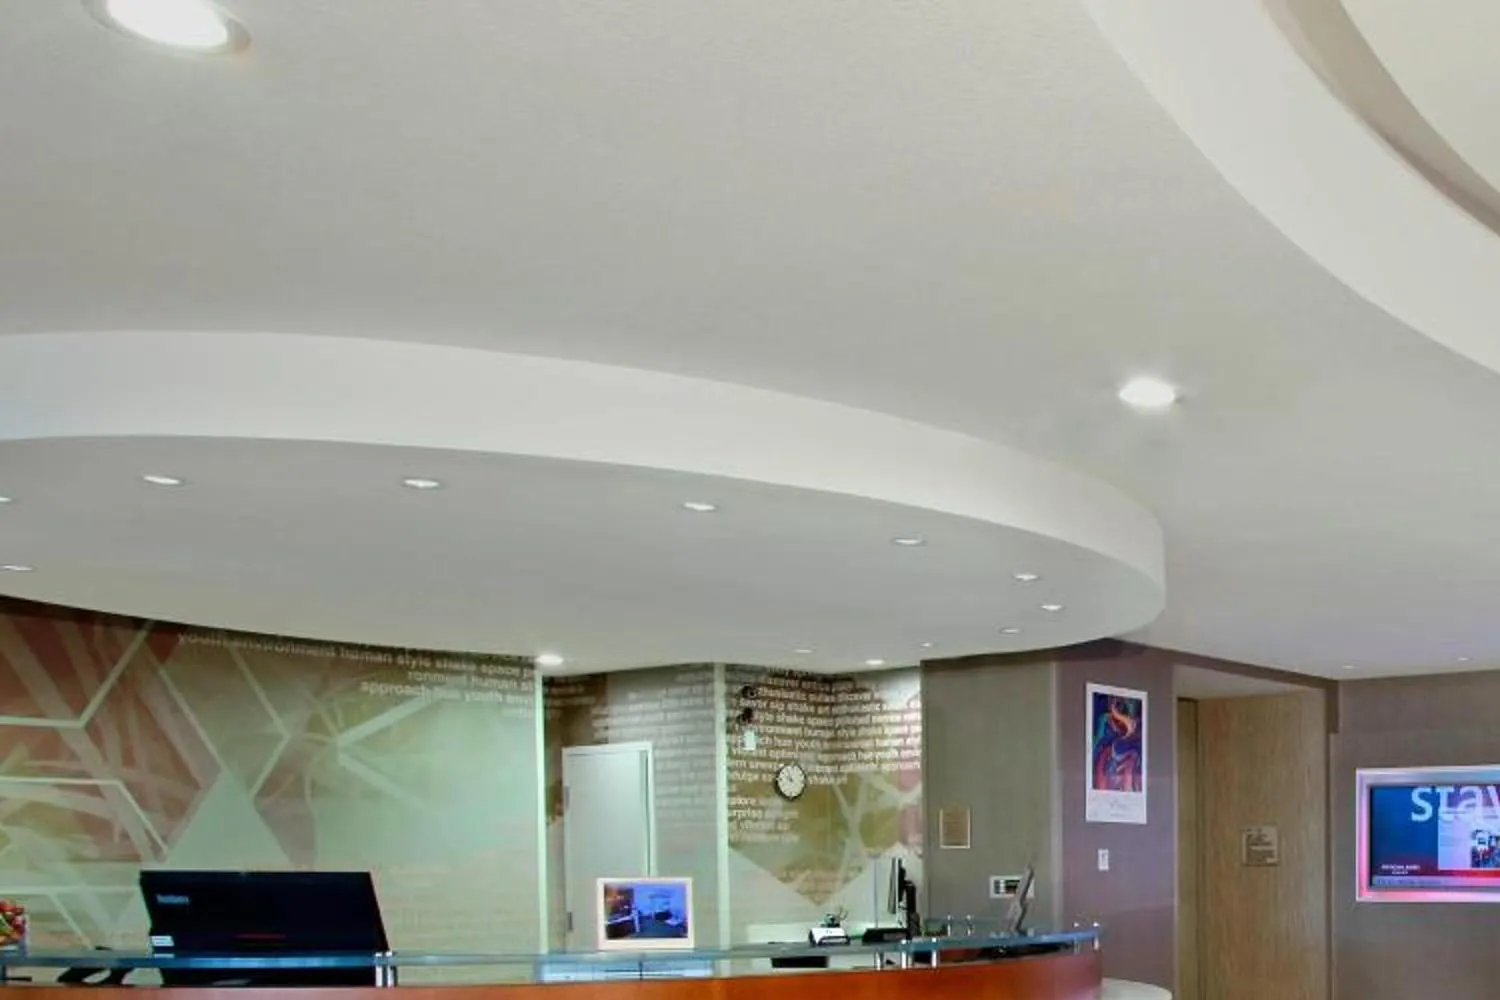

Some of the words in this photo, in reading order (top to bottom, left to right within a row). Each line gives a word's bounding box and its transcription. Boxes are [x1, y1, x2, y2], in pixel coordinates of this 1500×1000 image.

[340, 647, 393, 664] human
[397, 654, 432, 670] style
[481, 663, 521, 677] space
[360, 681, 432, 698] approach
[471, 675, 518, 690] human
